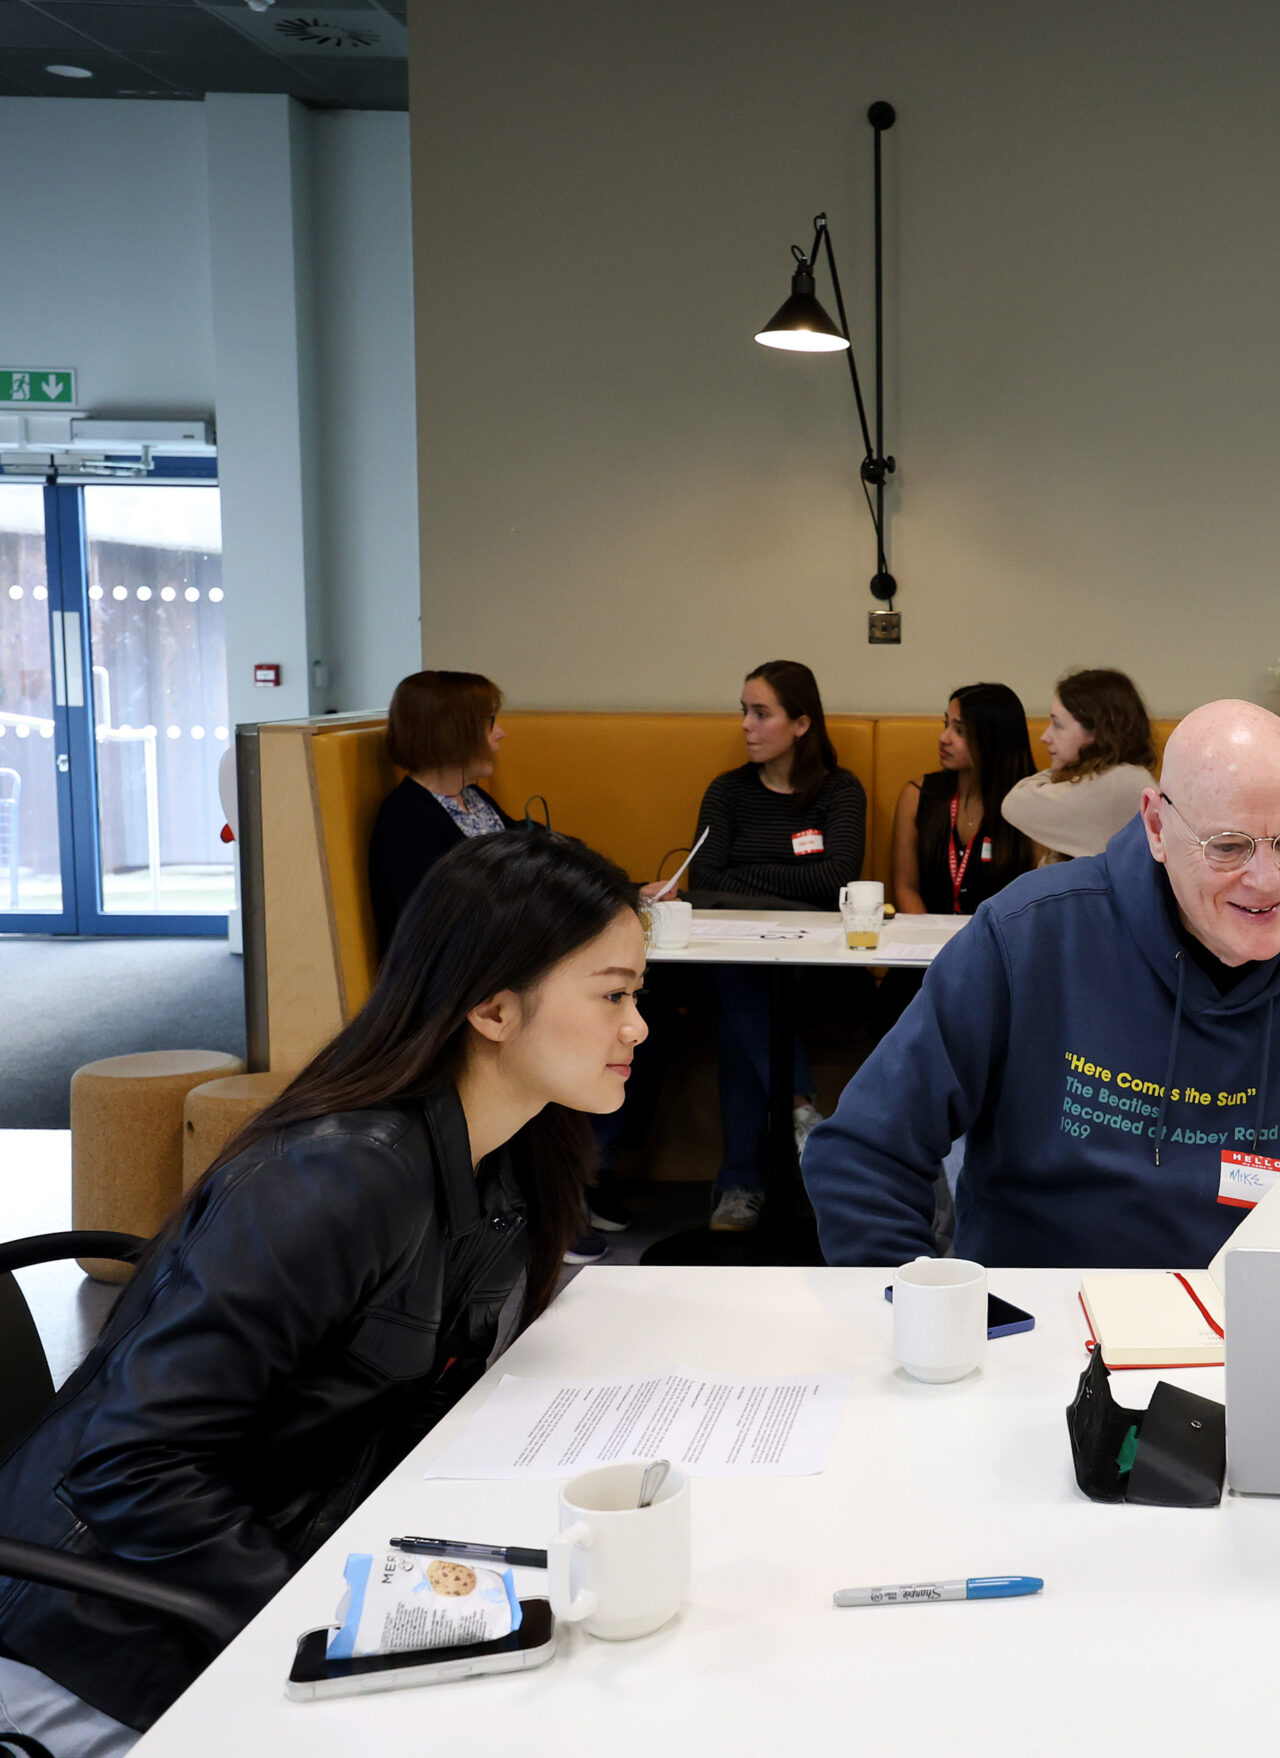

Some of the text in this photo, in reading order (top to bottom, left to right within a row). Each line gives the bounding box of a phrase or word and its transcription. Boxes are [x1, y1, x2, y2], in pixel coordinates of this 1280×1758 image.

[1066, 1075, 1160, 1118] The Beatles
[1185, 1087, 1211, 1105] the
[1060, 1116, 1091, 1139] 1969
[1063, 1096, 1144, 1135] Recorded
[1171, 1128, 1228, 1145] Abbey
[1234, 1125, 1279, 1140] Road
[1229, 1168, 1264, 1187] MIKE
[903, 1588, 941, 1600] Sharpie
